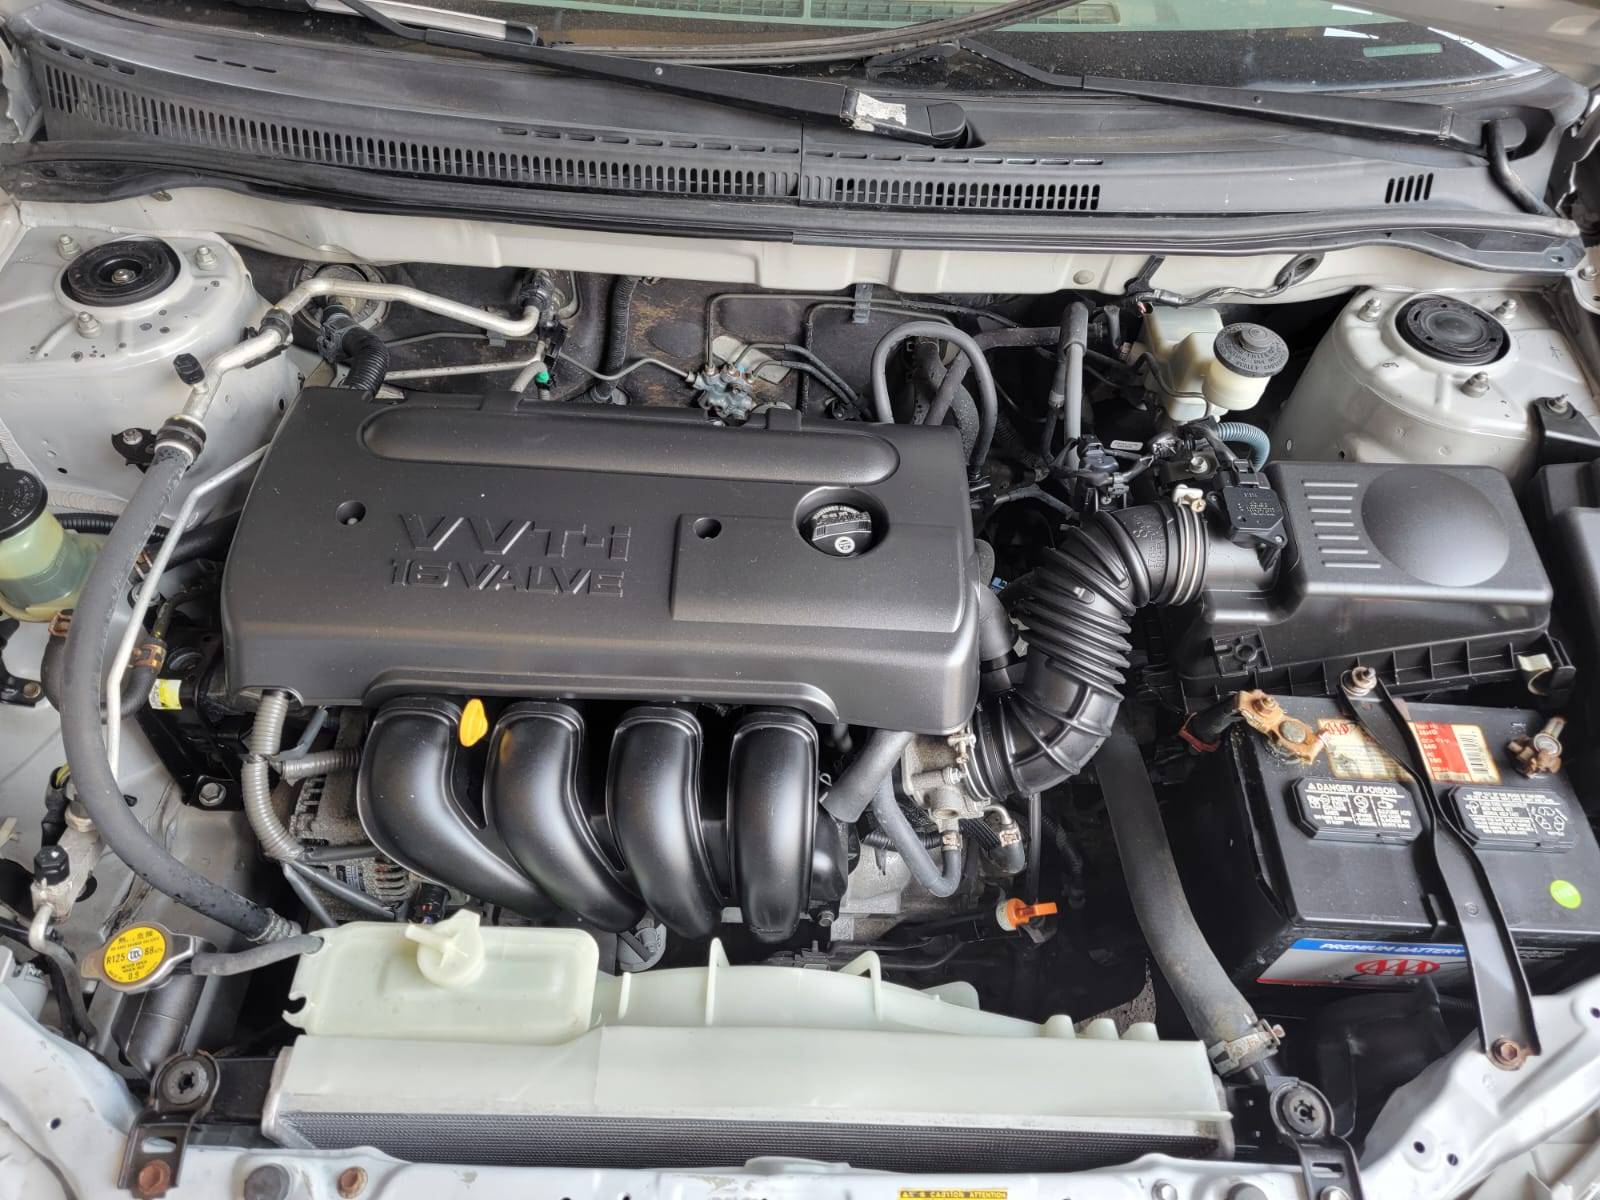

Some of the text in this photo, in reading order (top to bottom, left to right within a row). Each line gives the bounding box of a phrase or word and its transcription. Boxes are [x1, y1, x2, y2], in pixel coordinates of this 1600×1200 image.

[1315, 784, 1354, 793] DANGER
[1362, 786, 1398, 796] POISON
[1319, 943, 1465, 955] PREMIUM BATTERY
[106, 953, 126, 965] R125
[1354, 958, 1441, 977] AAA
[930, 1191, 964, 1199] CAUTION
[969, 1191, 1007, 1199] ATTENTION
